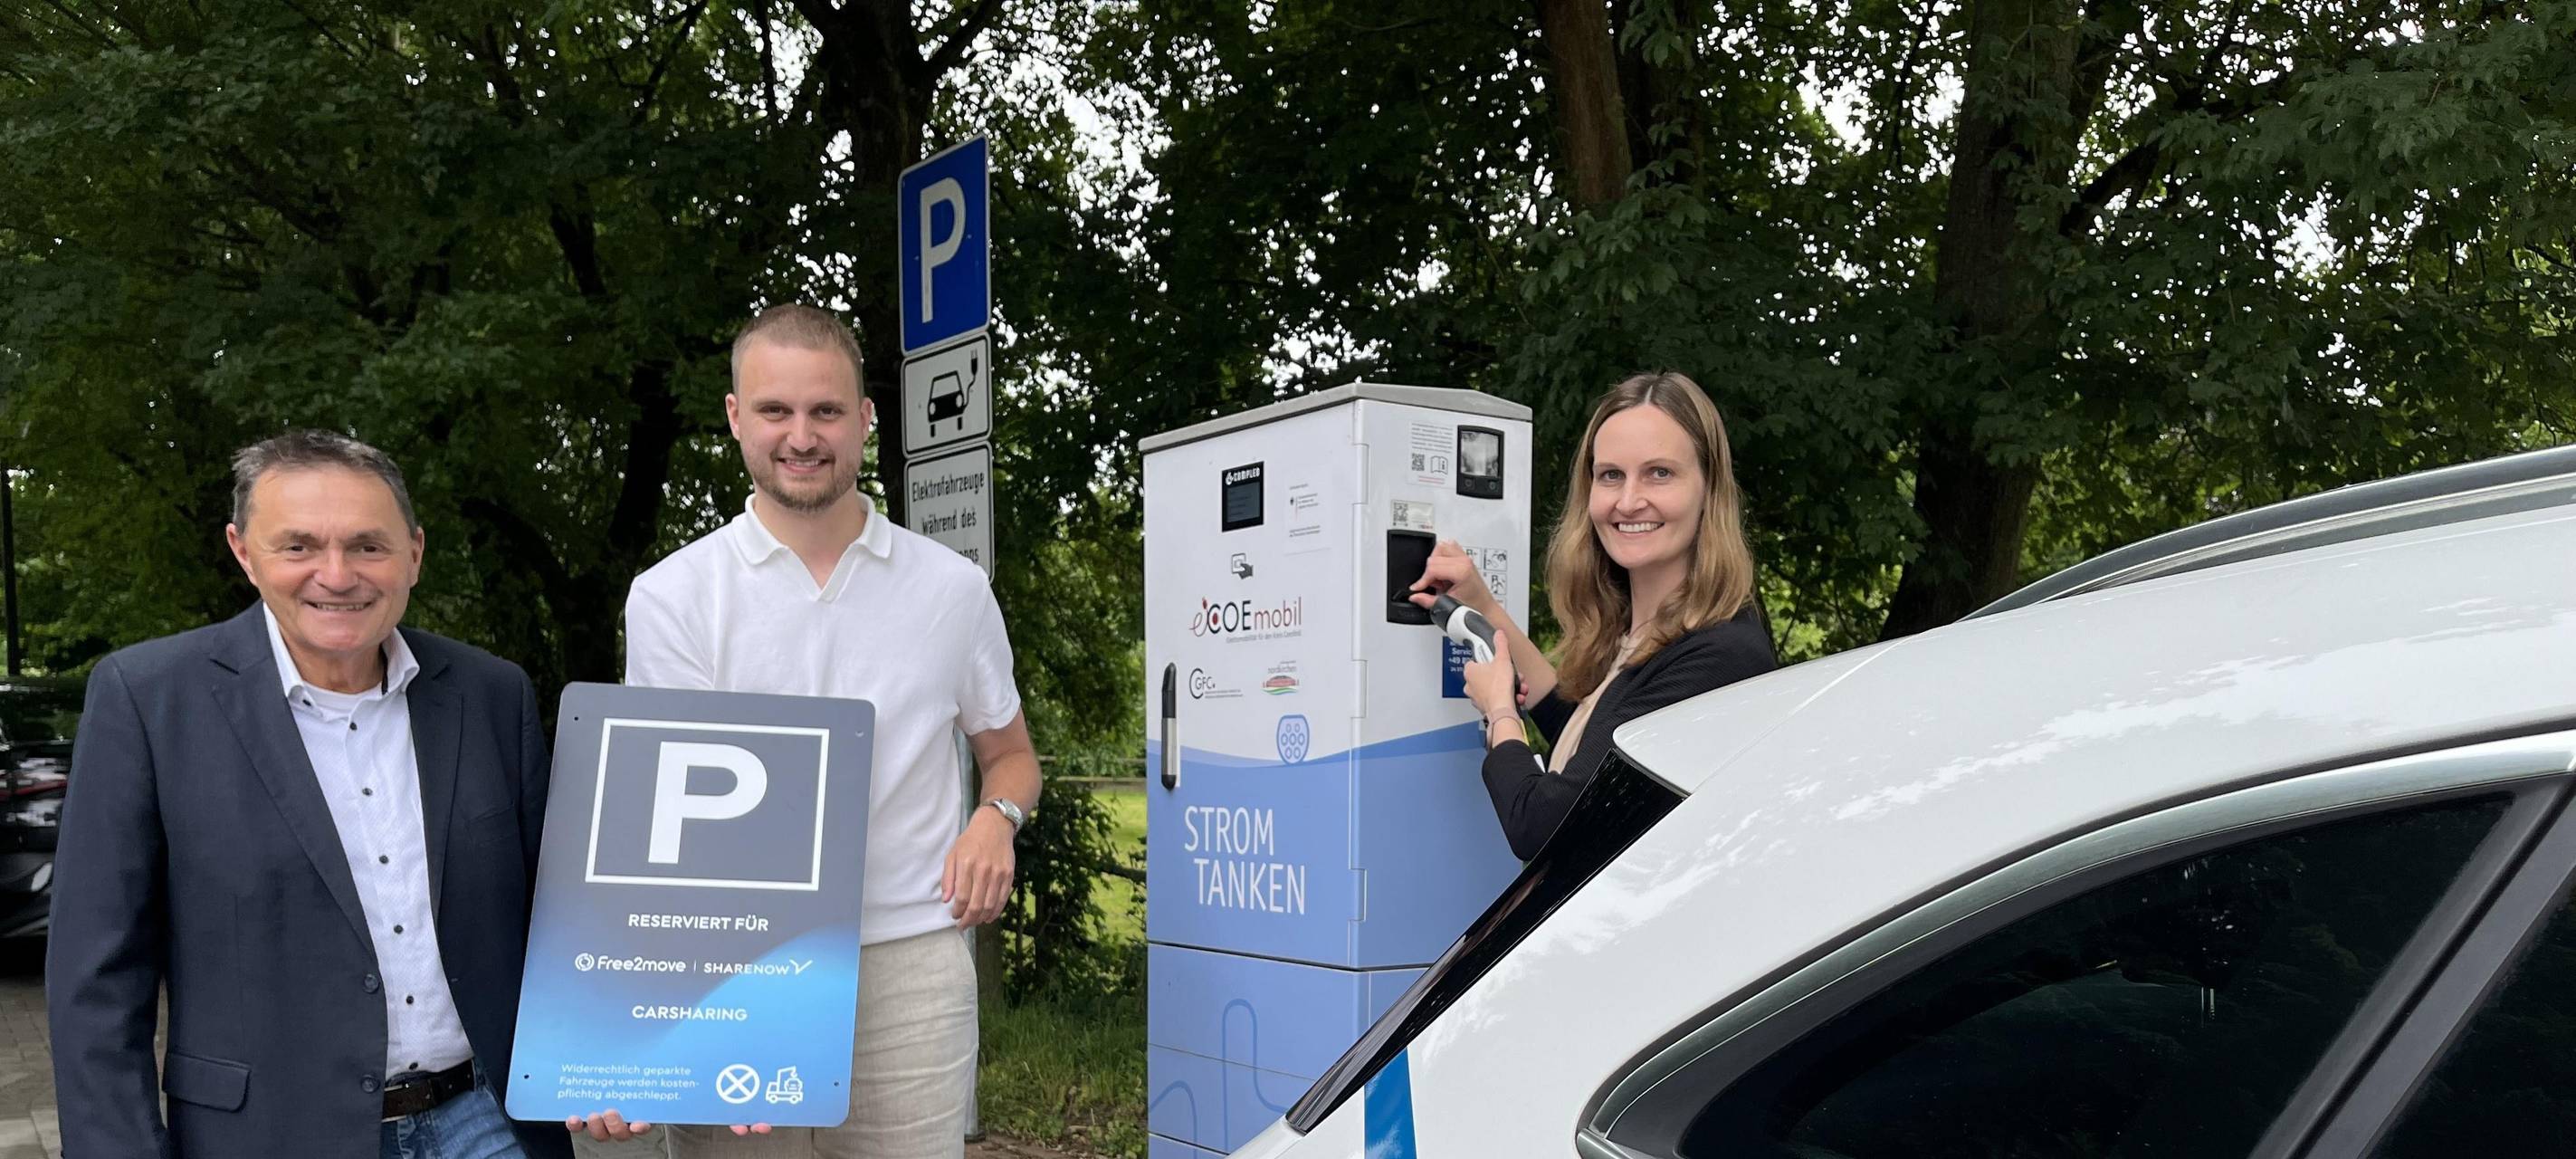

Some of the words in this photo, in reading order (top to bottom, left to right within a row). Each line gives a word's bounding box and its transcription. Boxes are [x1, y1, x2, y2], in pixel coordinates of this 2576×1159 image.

[920, 176, 967, 324] P
[911, 472, 985, 503] Elektrofahrzeuge
[921, 508, 958, 535] während
[961, 507, 977, 528] des
[1452, 646, 1473, 656] Servic
[648, 741, 768, 864] P
[1184, 805, 1274, 856] STROM
[1193, 857, 1305, 915] TANKEN
[628, 914, 731, 930] RESERVIERT
[734, 915, 769, 932] FÜR
[597, 954, 687, 973] Free2move
[703, 961, 790, 975] SHARENOW
[632, 1005, 749, 1021] CARSHARING
[561, 1063, 641, 1074] Widerrechtlich
[643, 1065, 692, 1078] geparkte
[559, 1075, 615, 1088] Fahrzeuge
[617, 1077, 658, 1087] werden
[660, 1078, 700, 1088] kosten-
[557, 1088, 603, 1101] pflichtig
[605, 1089, 682, 1102] abgeschleppt.
